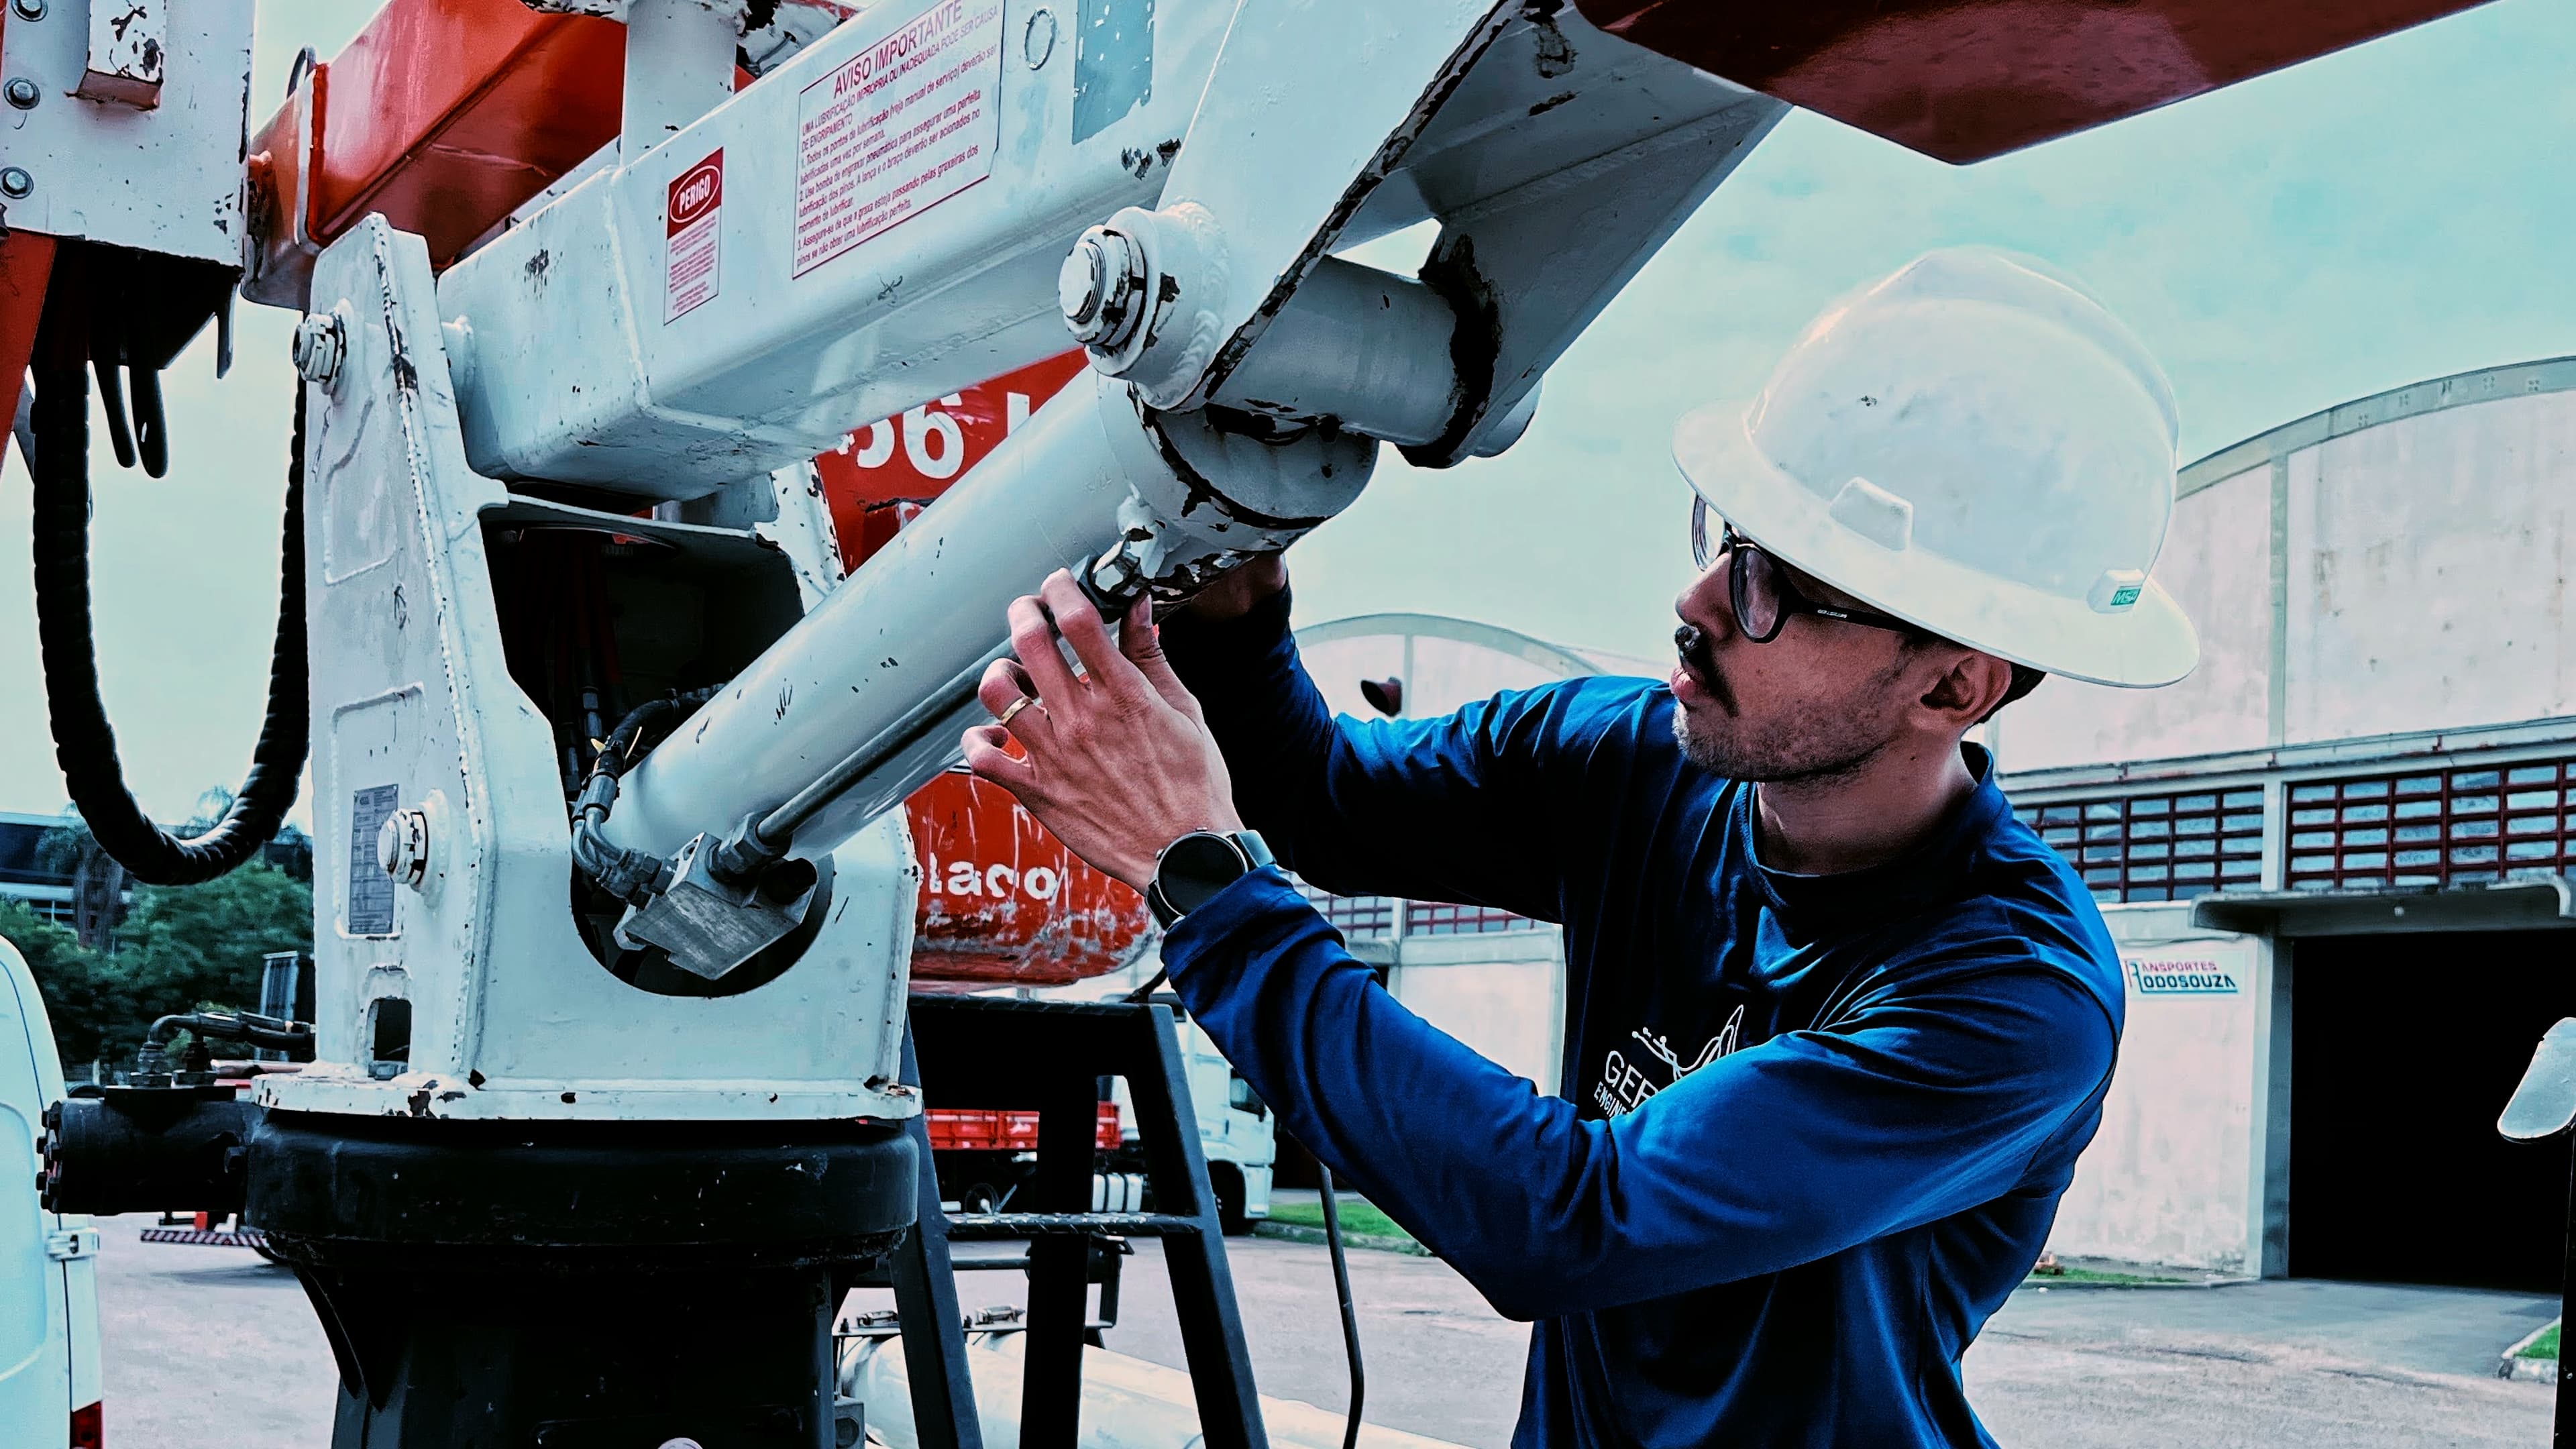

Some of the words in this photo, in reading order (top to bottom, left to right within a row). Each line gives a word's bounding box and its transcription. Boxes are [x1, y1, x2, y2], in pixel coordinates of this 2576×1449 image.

[834, 54, 870, 99] AVISO
[875, 1, 961, 72] IMPORTANTE
[680, 174, 710, 214] PERIGO
[1594, 1081, 1631, 1118] ENGIN
